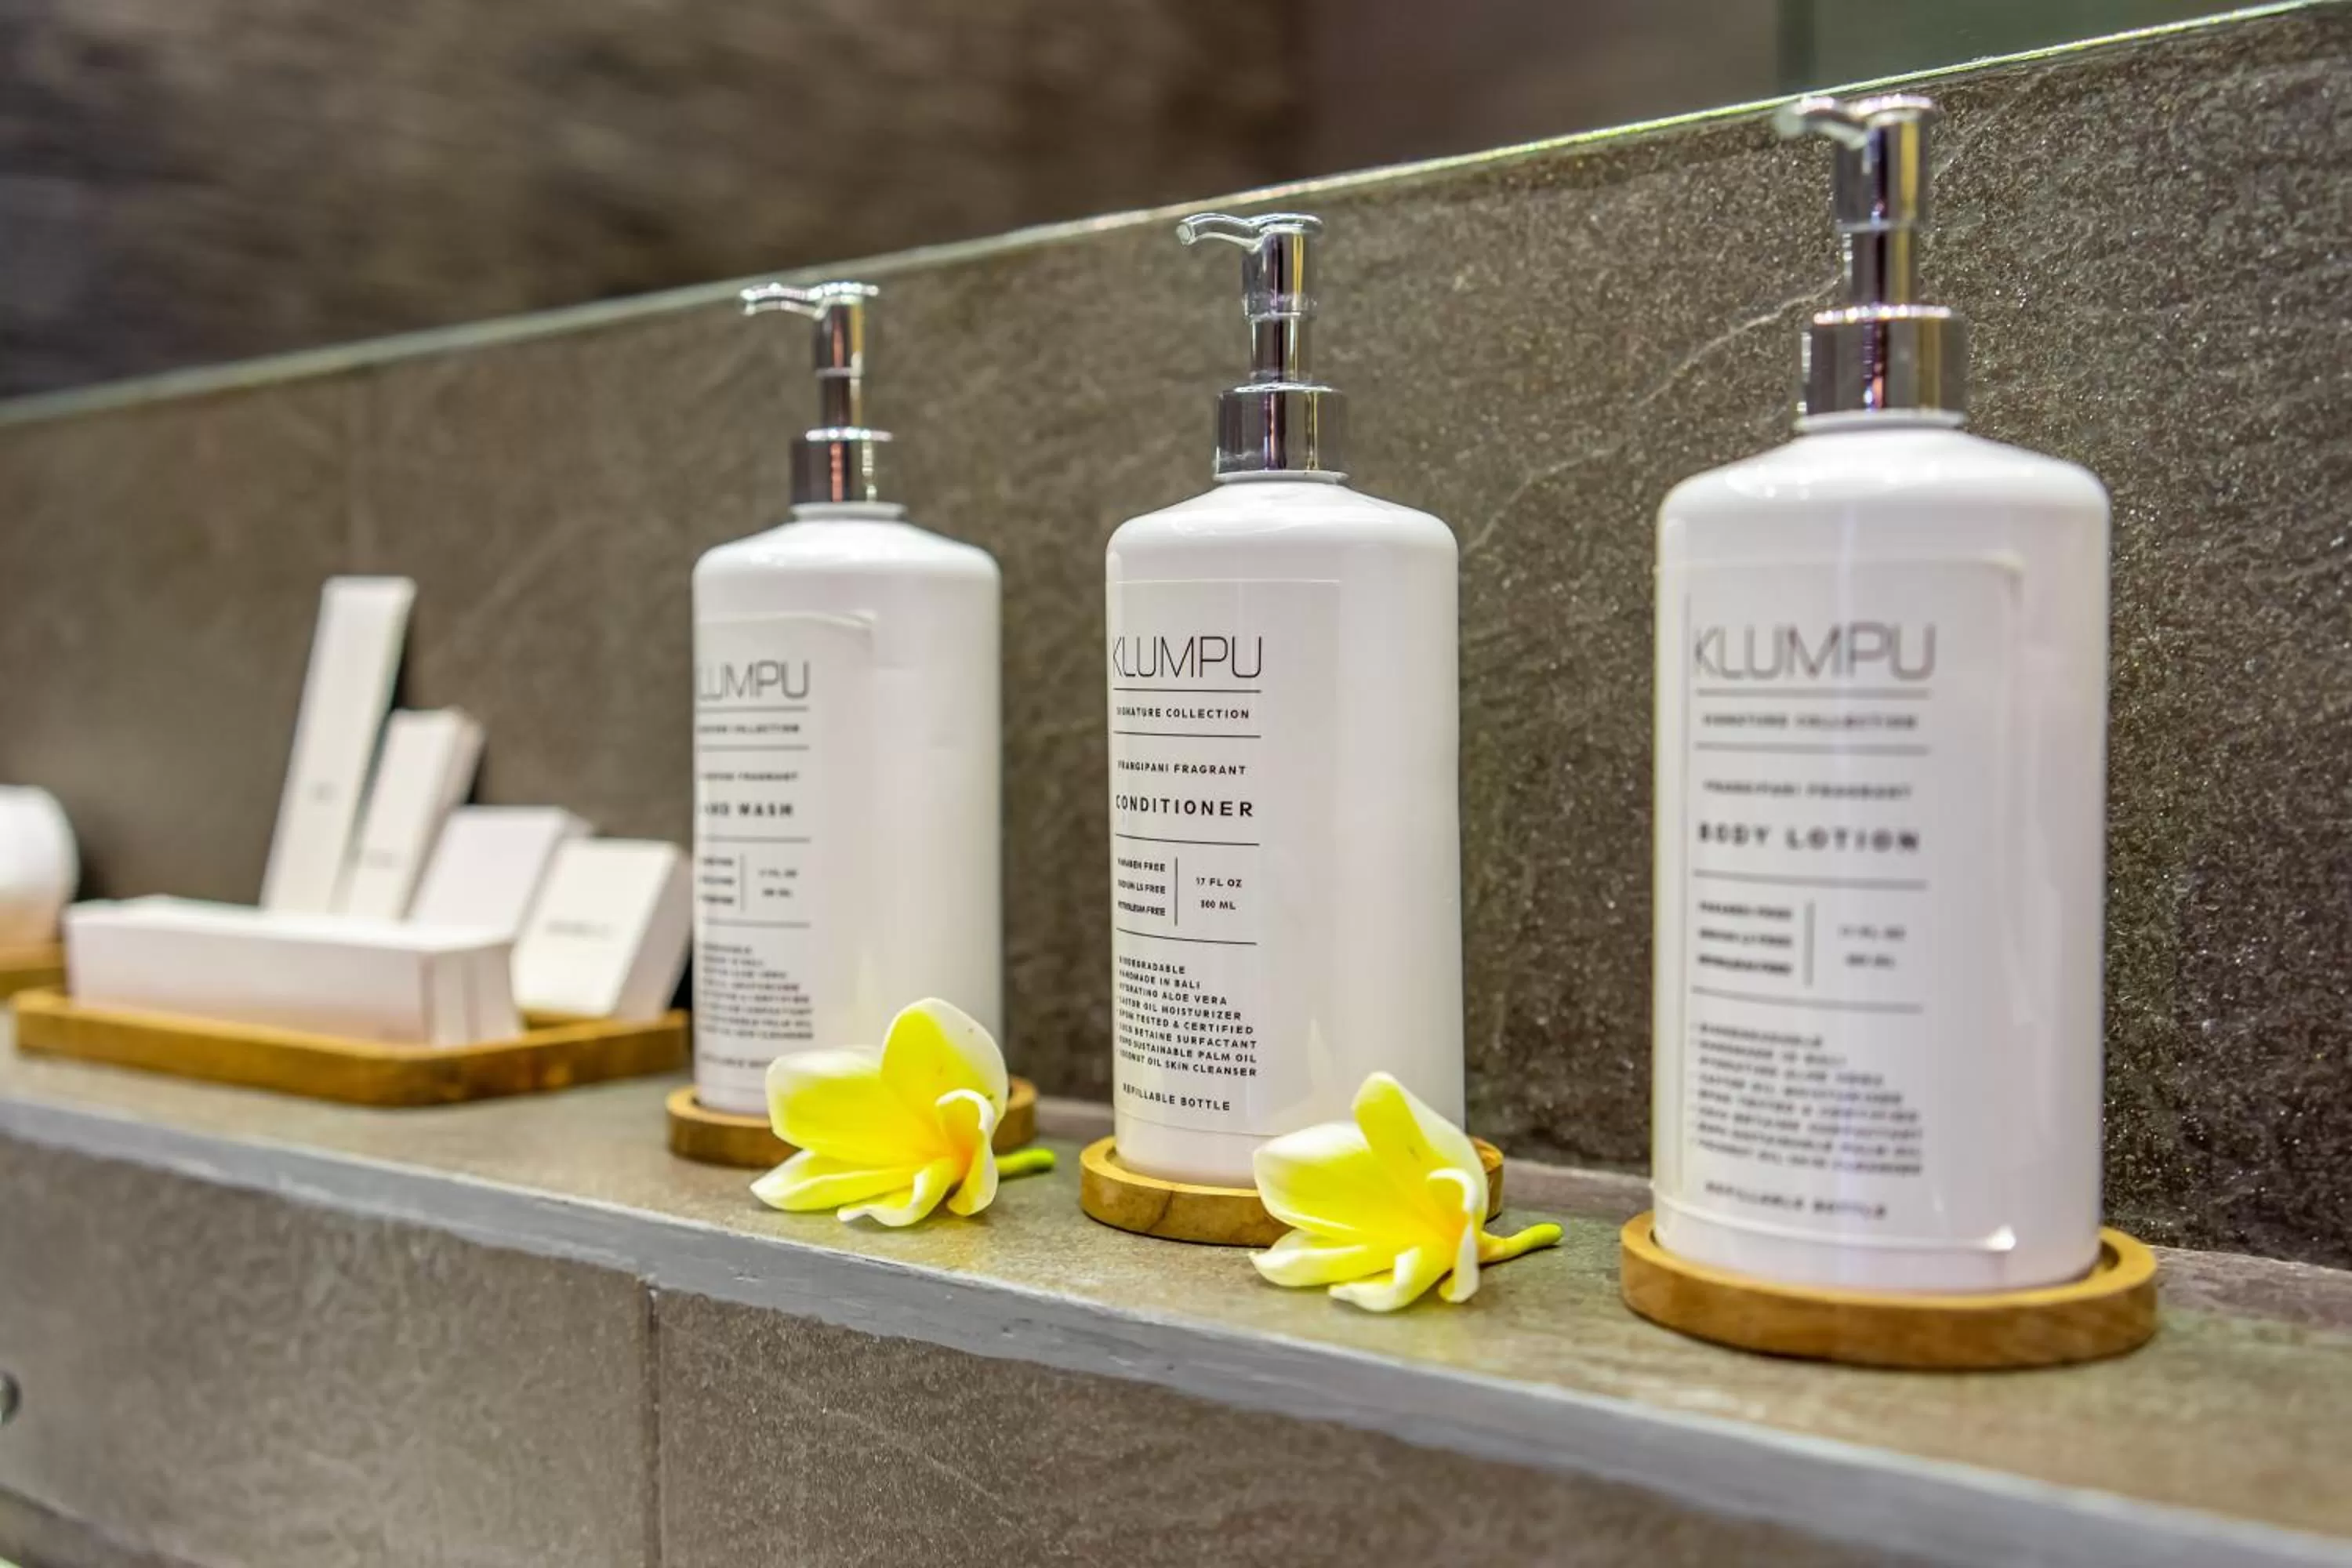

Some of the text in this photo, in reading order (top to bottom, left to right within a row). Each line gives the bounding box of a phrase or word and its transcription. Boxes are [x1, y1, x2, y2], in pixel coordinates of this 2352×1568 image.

[1112, 636, 1261, 678] KLUMPU
[1693, 622, 1936, 681] KLUMPU
[1166, 708, 1249, 719] COLLECTION
[1174, 764, 1247, 775] FRAGRANT
[1116, 794, 1254, 817] CONDITIONER
[1196, 877, 1242, 887] 17 FL OZ
[1219, 901, 1236, 909] ML
[1160, 977, 1170, 986] IN
[1174, 980, 1200, 989] BALI
[1162, 993, 1189, 1002] ALOE
[1194, 996, 1227, 1005] VERA
[1142, 1004, 1157, 1012] OIL
[1161, 1006, 1241, 1020] MOISTURIZER
[1136, 1014, 1169, 1028] TESTED
[1183, 1022, 1254, 1034] CERTIFIED
[1134, 1027, 1172, 1042] BETAINE
[1177, 1035, 1258, 1049] SURFACTANT
[1133, 1040, 1192, 1058] SUSTAINABLE
[1198, 1050, 1230, 1061] PALM
[1235, 1054, 1257, 1063] OIL
[1147, 1056, 1161, 1066] OIL
[1164, 1061, 1189, 1071] SKIN
[1192, 1065, 1256, 1076] CLEANSER
[1180, 1097, 1230, 1111] BOTTLE
